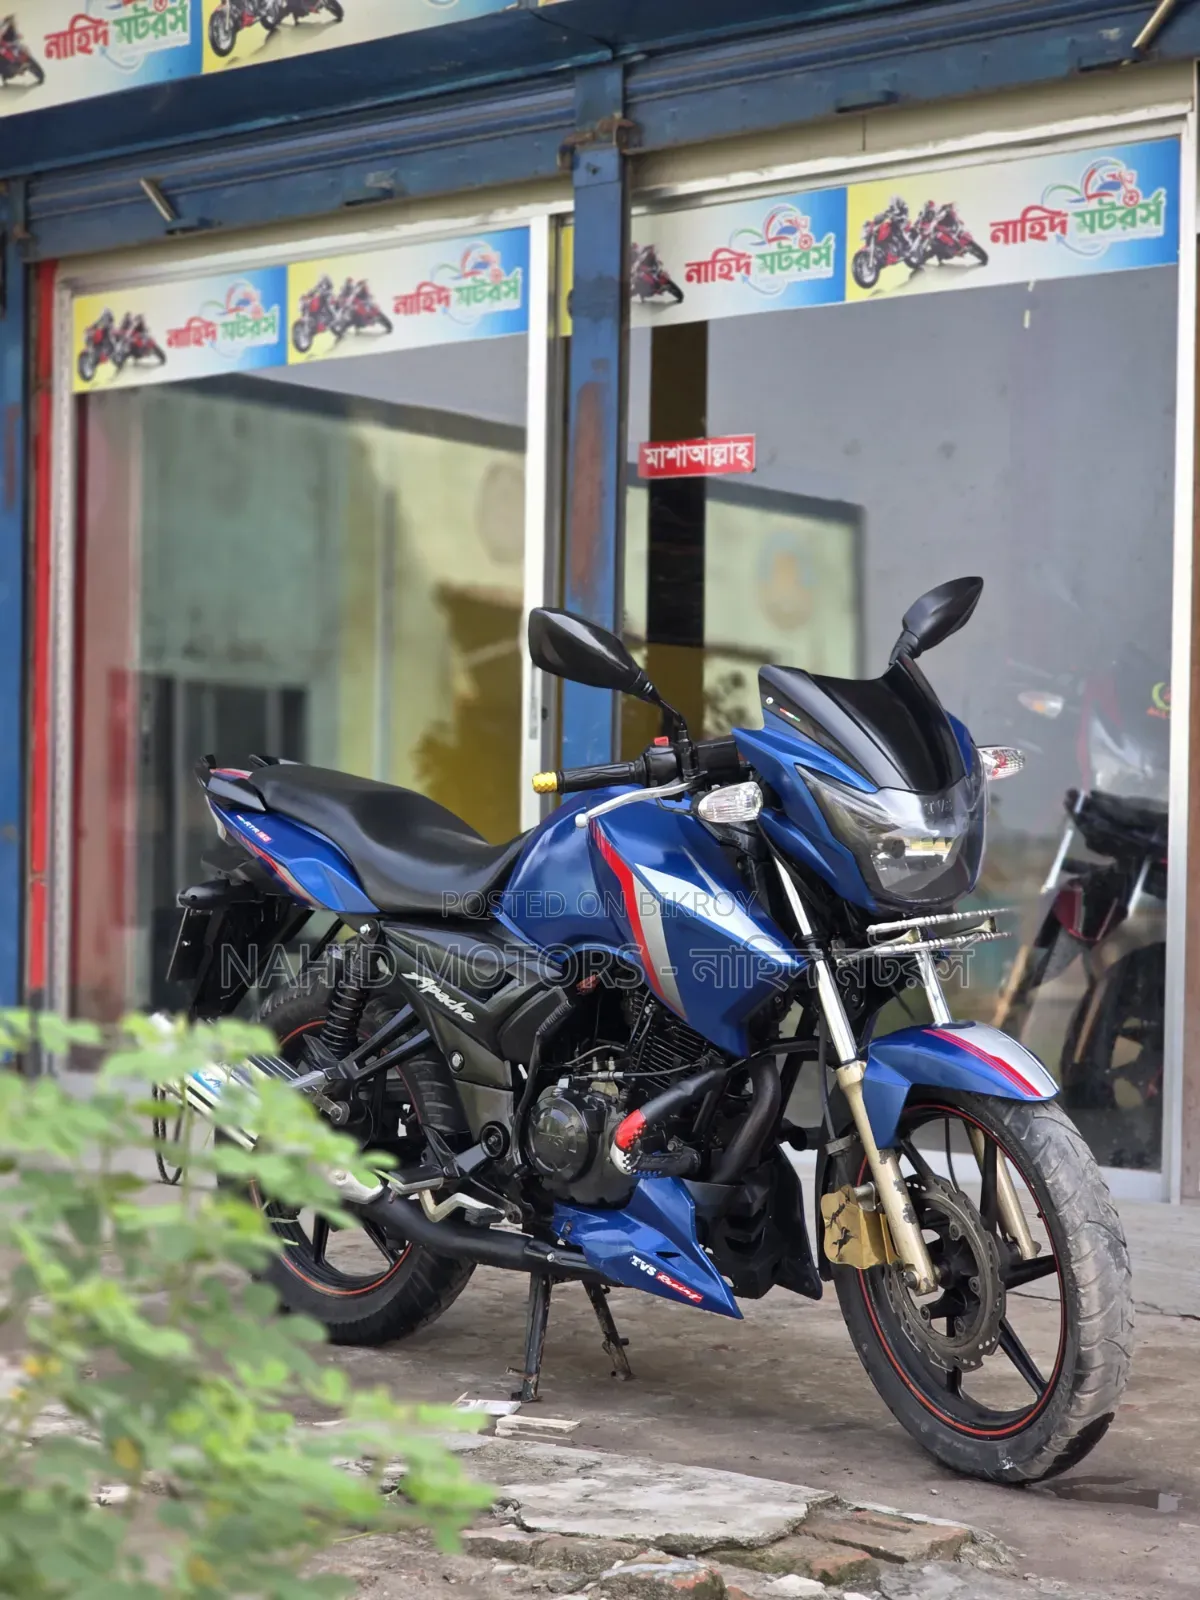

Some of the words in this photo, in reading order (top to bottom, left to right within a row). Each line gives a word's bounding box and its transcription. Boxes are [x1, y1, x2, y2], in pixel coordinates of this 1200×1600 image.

[44, 13, 109, 59] নাহিদ
[990, 205, 1068, 245] নাহিদ
[684, 247, 752, 284] নাহিদ
[392, 281, 451, 316] নাহিদ
[166, 316, 217, 348] নাহিদ
[401, 972, 476, 1023] Apache
[631, 1255, 657, 1276] TVS
